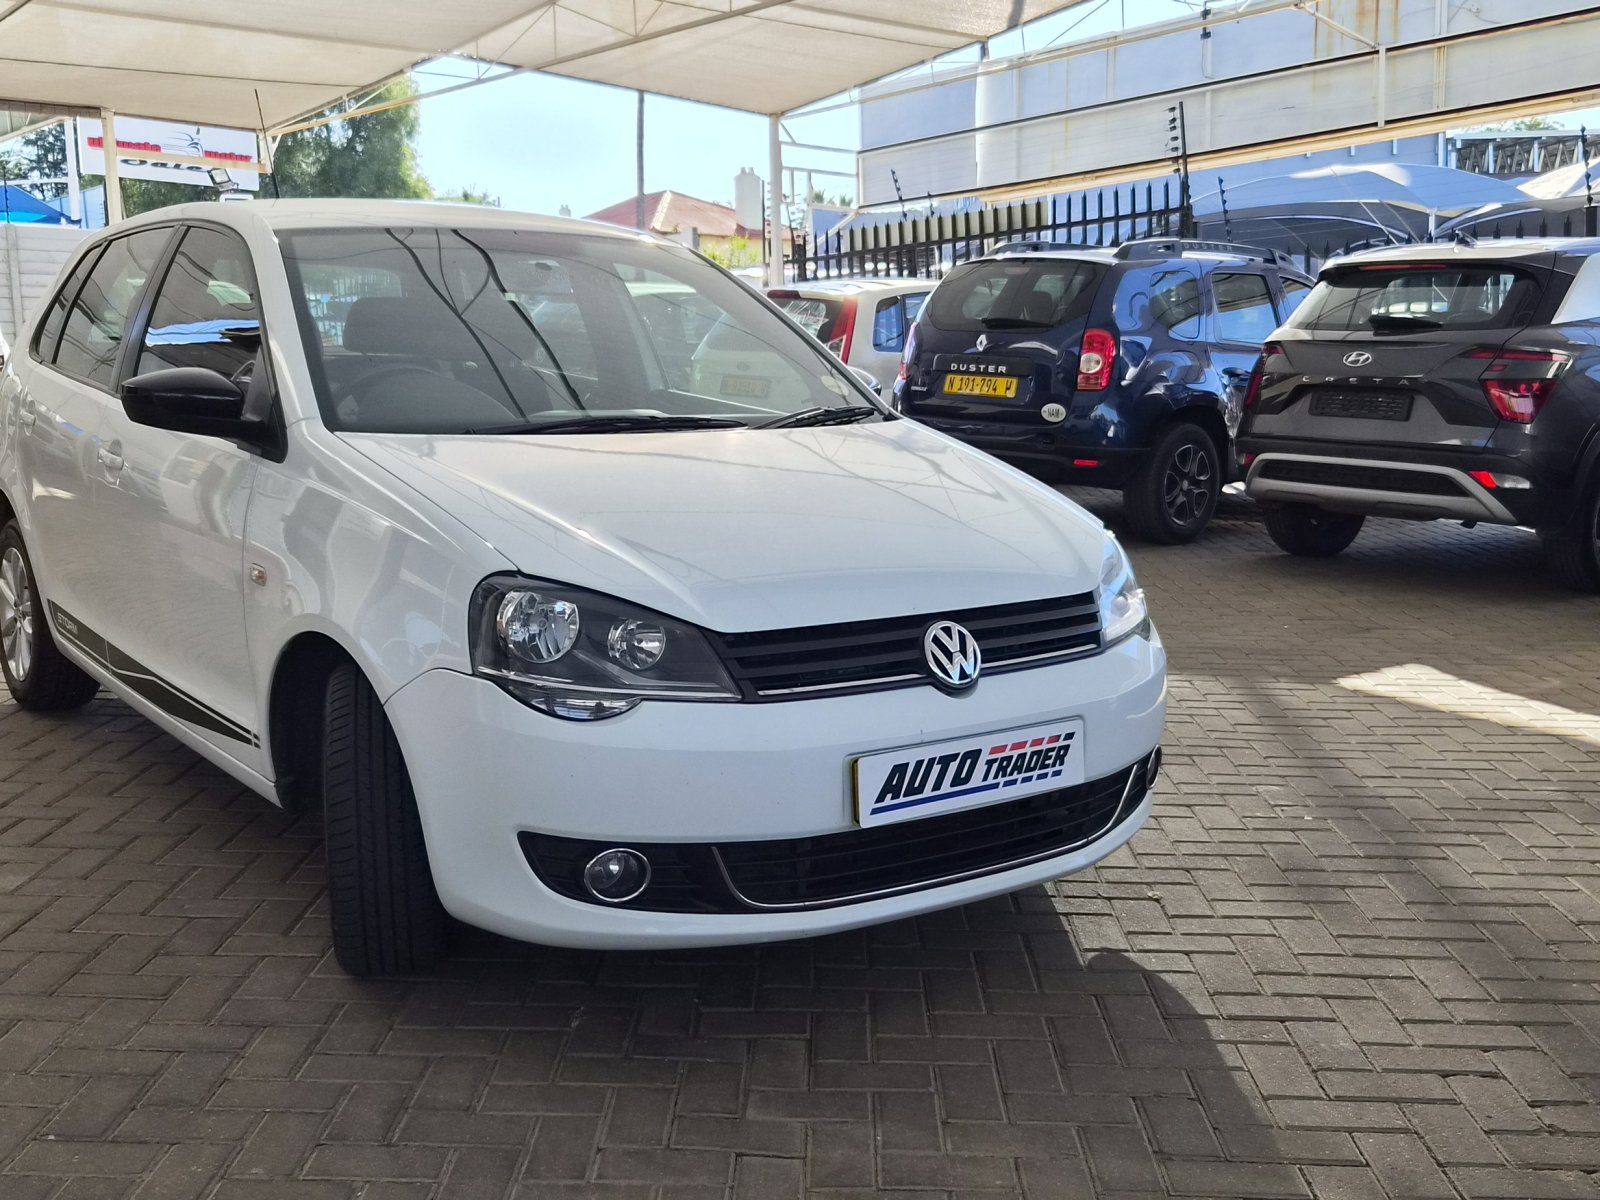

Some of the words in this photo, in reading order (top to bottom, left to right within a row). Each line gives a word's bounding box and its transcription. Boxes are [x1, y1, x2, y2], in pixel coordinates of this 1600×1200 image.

[950, 363, 1007, 374] DUSTER
[874, 748, 983, 804] AUTO
[981, 744, 1071, 782] TRADER
